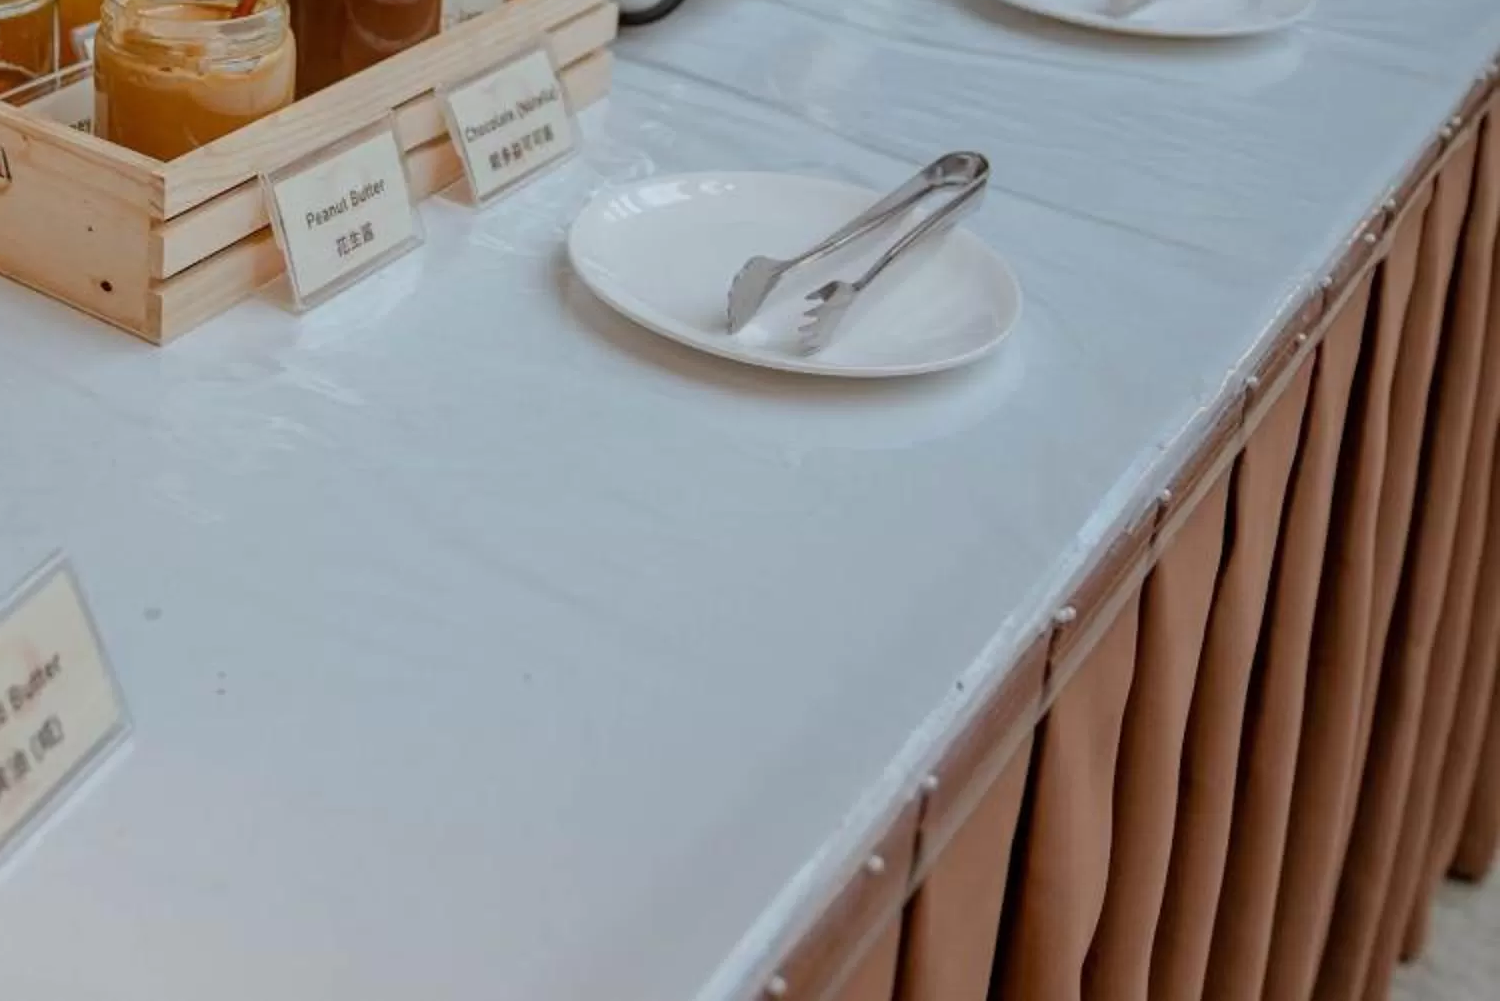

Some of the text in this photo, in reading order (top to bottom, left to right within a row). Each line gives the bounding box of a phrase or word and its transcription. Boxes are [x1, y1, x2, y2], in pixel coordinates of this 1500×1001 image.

[465, 109, 515, 143] Chocolate
[305, 179, 386, 230] Peanut Butter
[8, 652, 62, 712] Butter
